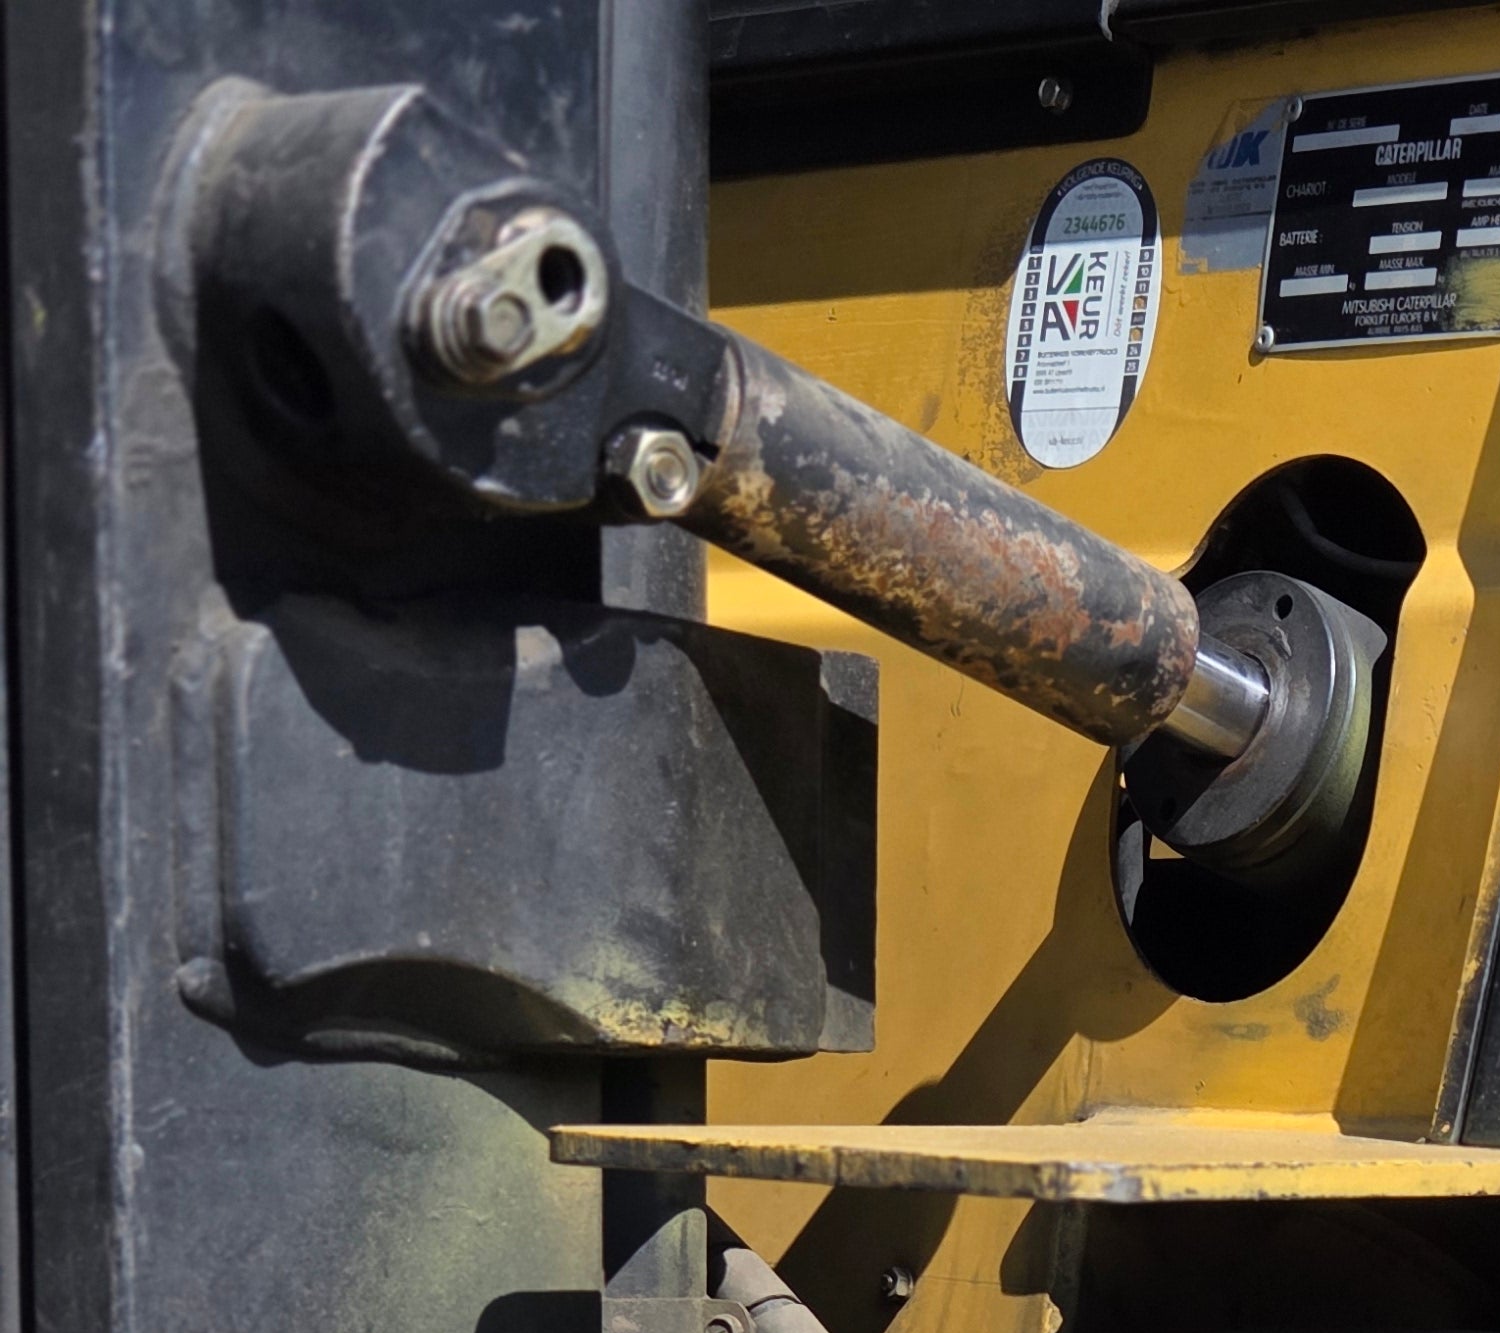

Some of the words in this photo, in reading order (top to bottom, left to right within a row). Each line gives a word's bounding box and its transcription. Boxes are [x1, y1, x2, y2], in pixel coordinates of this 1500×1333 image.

[1374, 137, 1463, 166] CATERPILLAR
[1063, 213, 1126, 235] 2344676
[1079, 251, 1109, 340] KEUR
[1341, 298, 1395, 315] MITSUBISHI
[1396, 292, 1458, 312] CATERPILLAR
